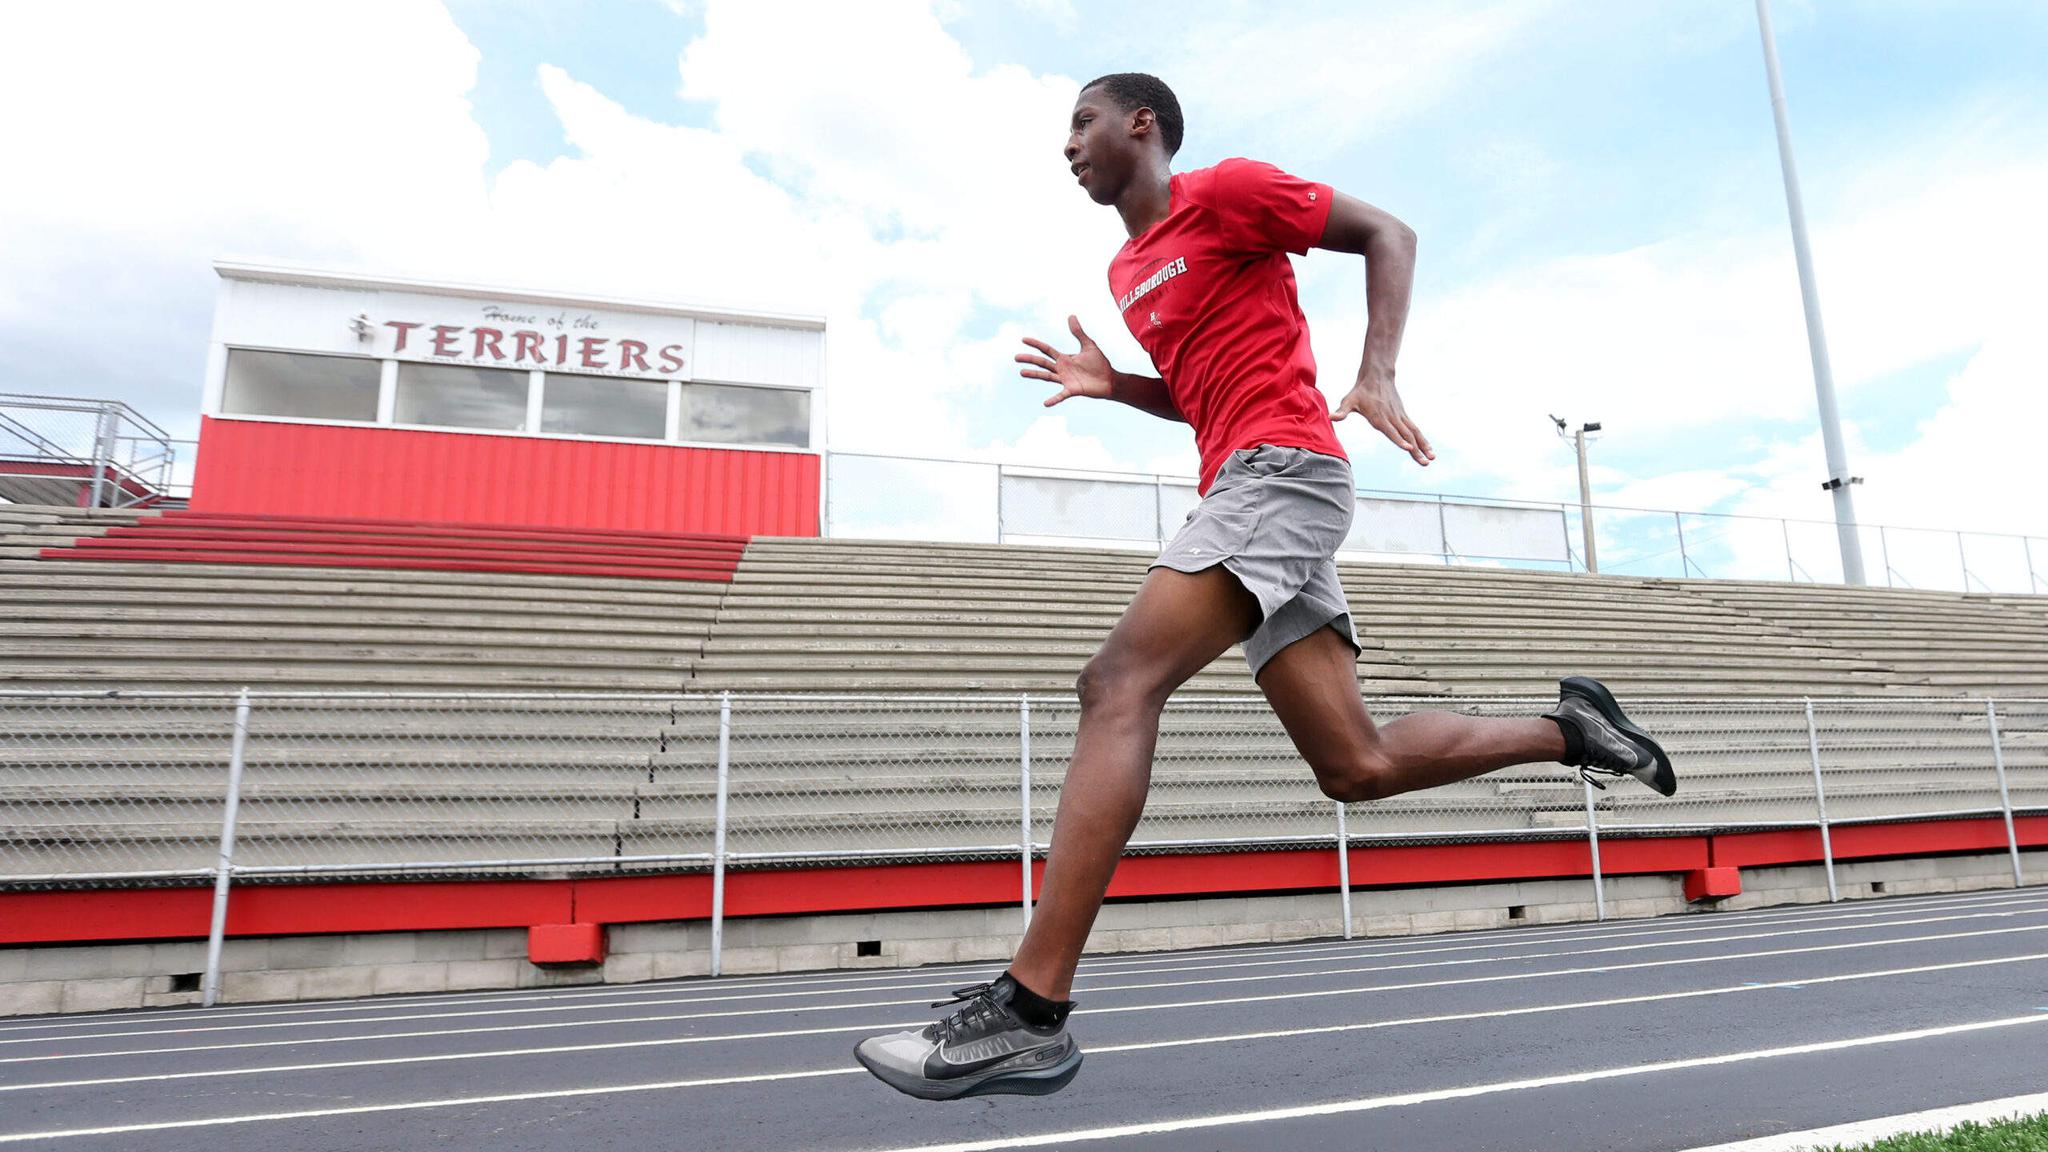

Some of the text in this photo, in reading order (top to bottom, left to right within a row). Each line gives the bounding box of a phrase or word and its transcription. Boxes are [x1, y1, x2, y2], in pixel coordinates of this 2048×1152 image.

[482, 305, 599, 330] Home of the
[384, 320, 685, 374] TERRIERS
